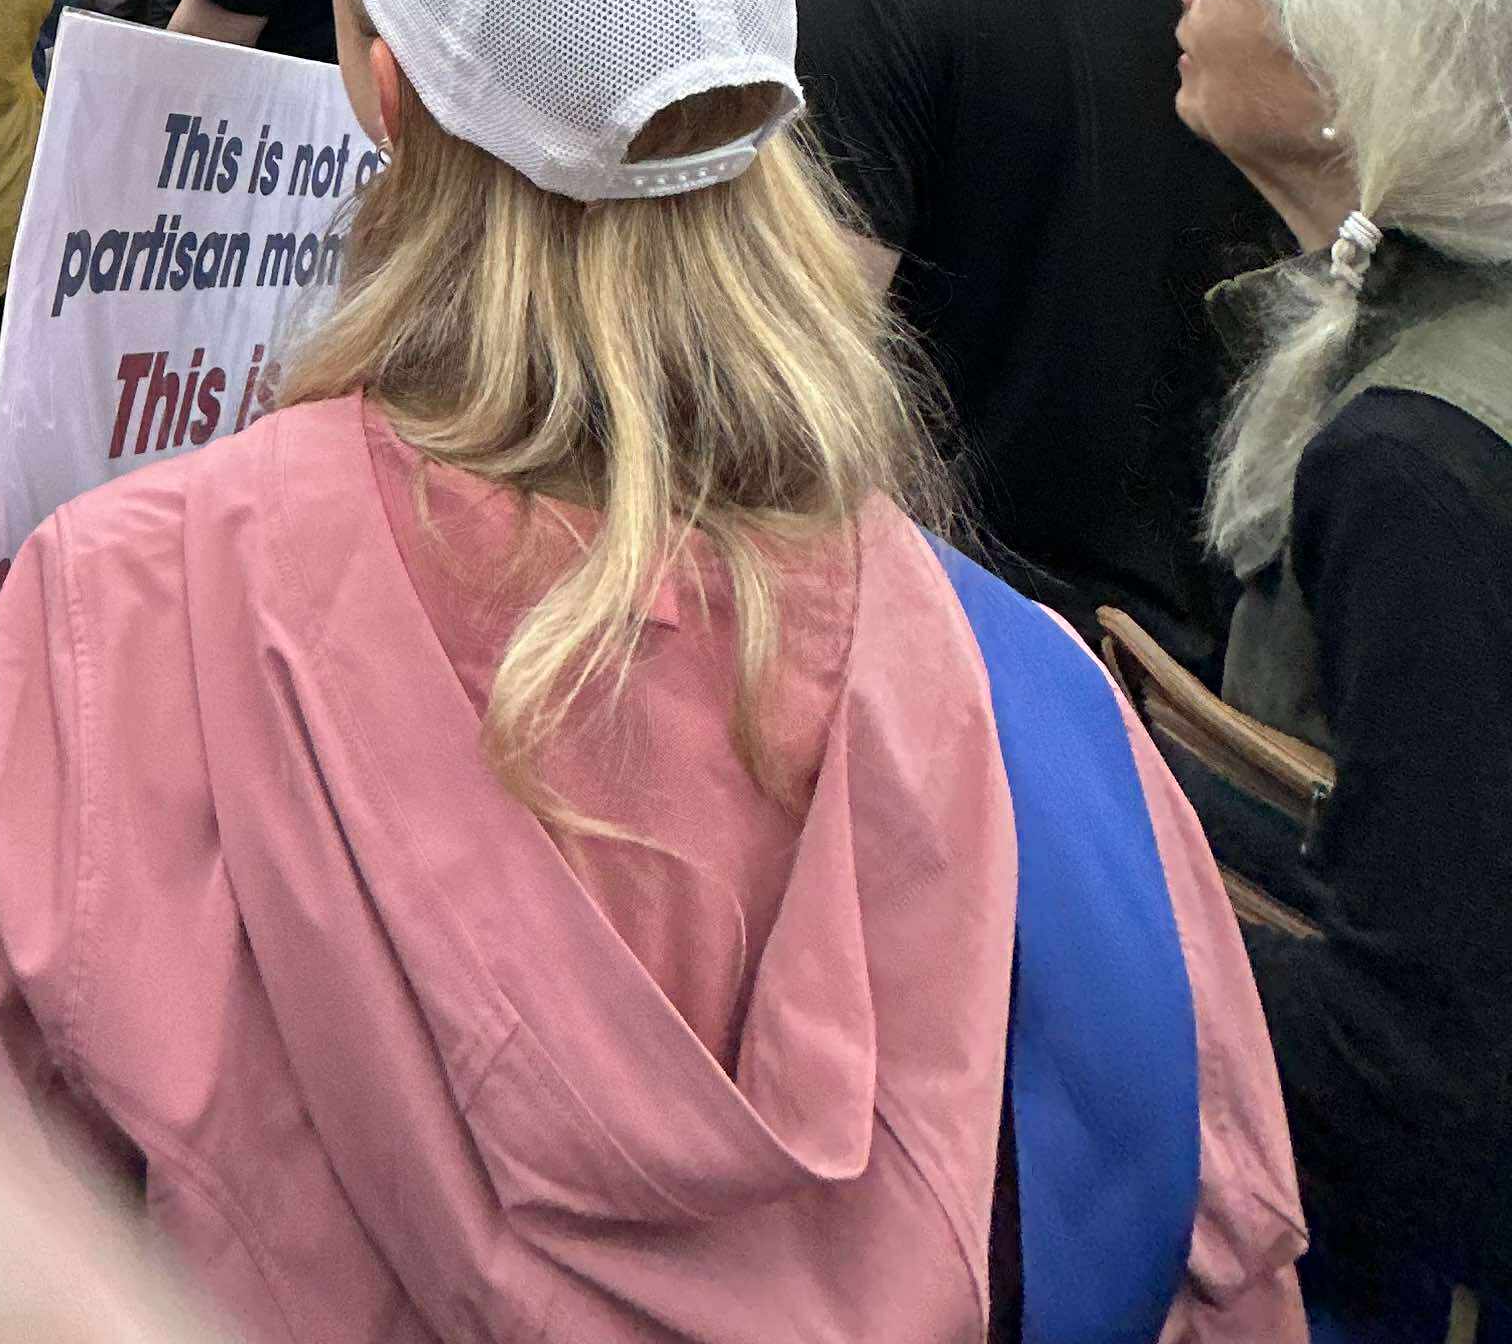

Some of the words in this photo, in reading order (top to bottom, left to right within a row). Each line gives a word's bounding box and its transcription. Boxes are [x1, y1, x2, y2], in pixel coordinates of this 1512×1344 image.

[157, 112, 243, 194] This
[248, 124, 284, 196] is
[288, 134, 351, 199] not
[50, 214, 252, 318] partisan
[109, 348, 226, 459] This
